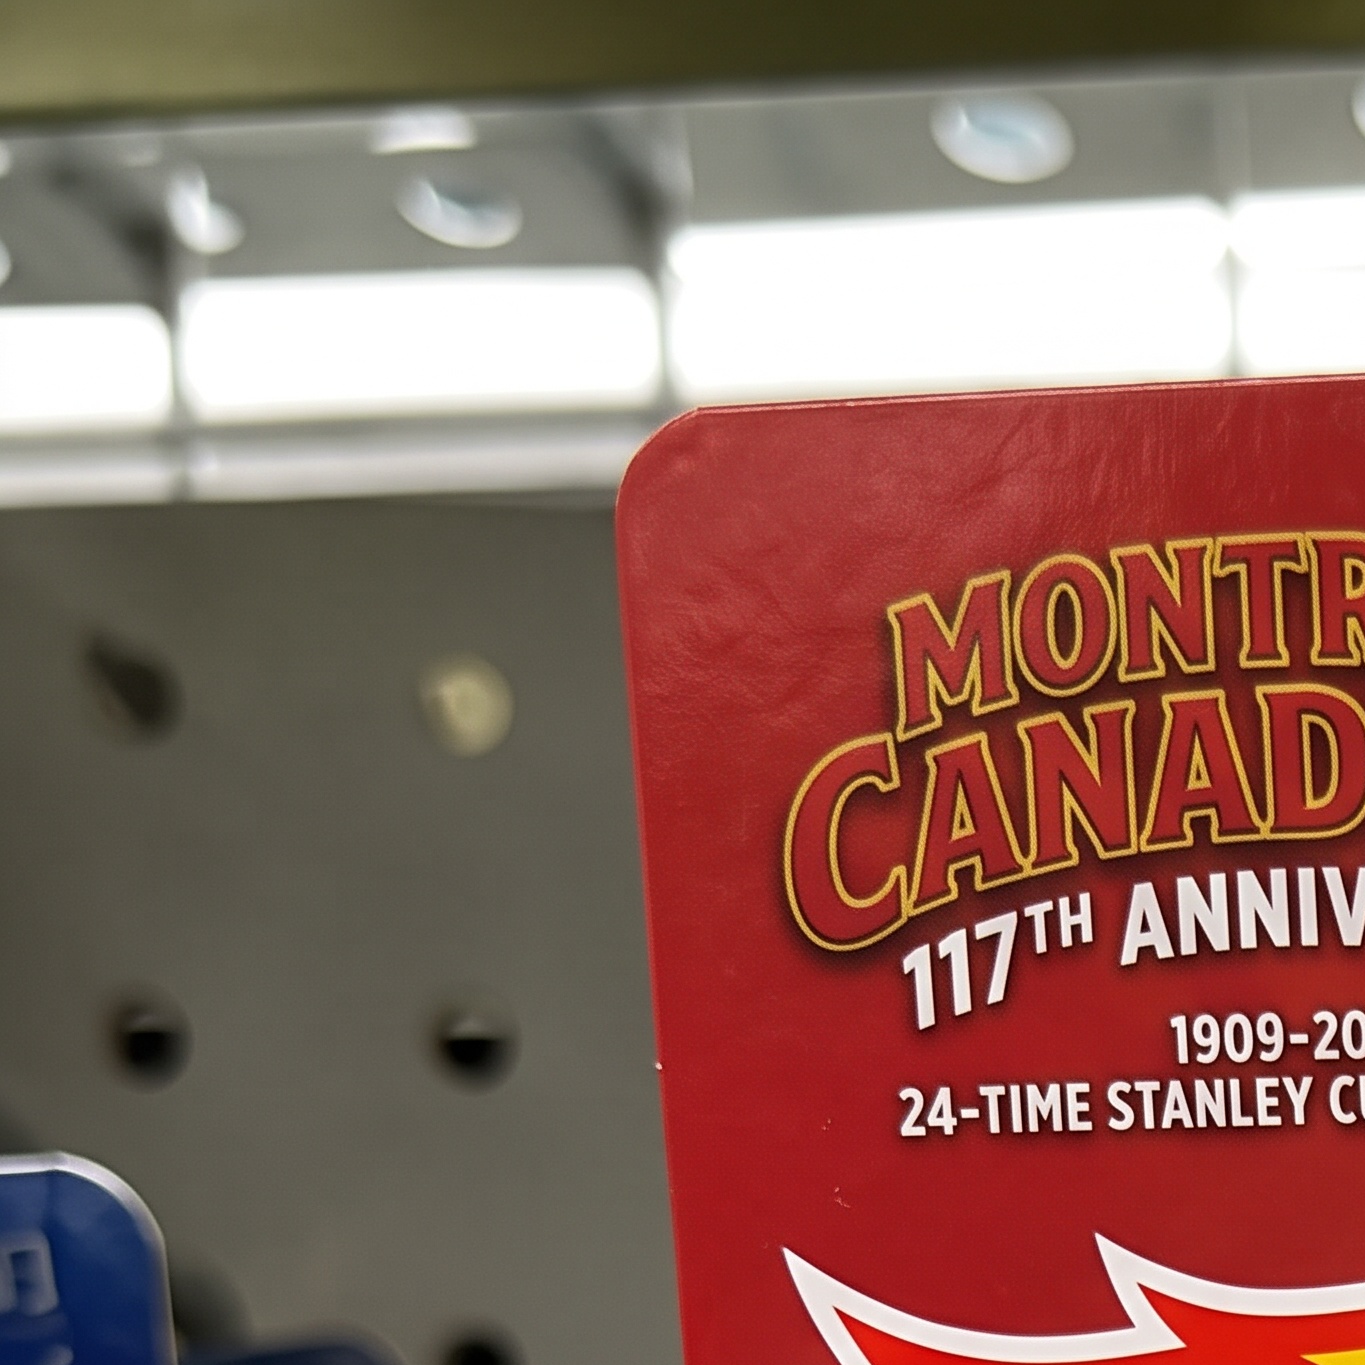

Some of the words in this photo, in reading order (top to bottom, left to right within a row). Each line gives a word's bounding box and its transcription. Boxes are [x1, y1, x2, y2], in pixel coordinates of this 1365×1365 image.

[902, 893, 1092, 1030] 117TH
[898, 1081, 1093, 1138] 24-TIME
[1106, 1076, 1311, 1132] STANLEY
